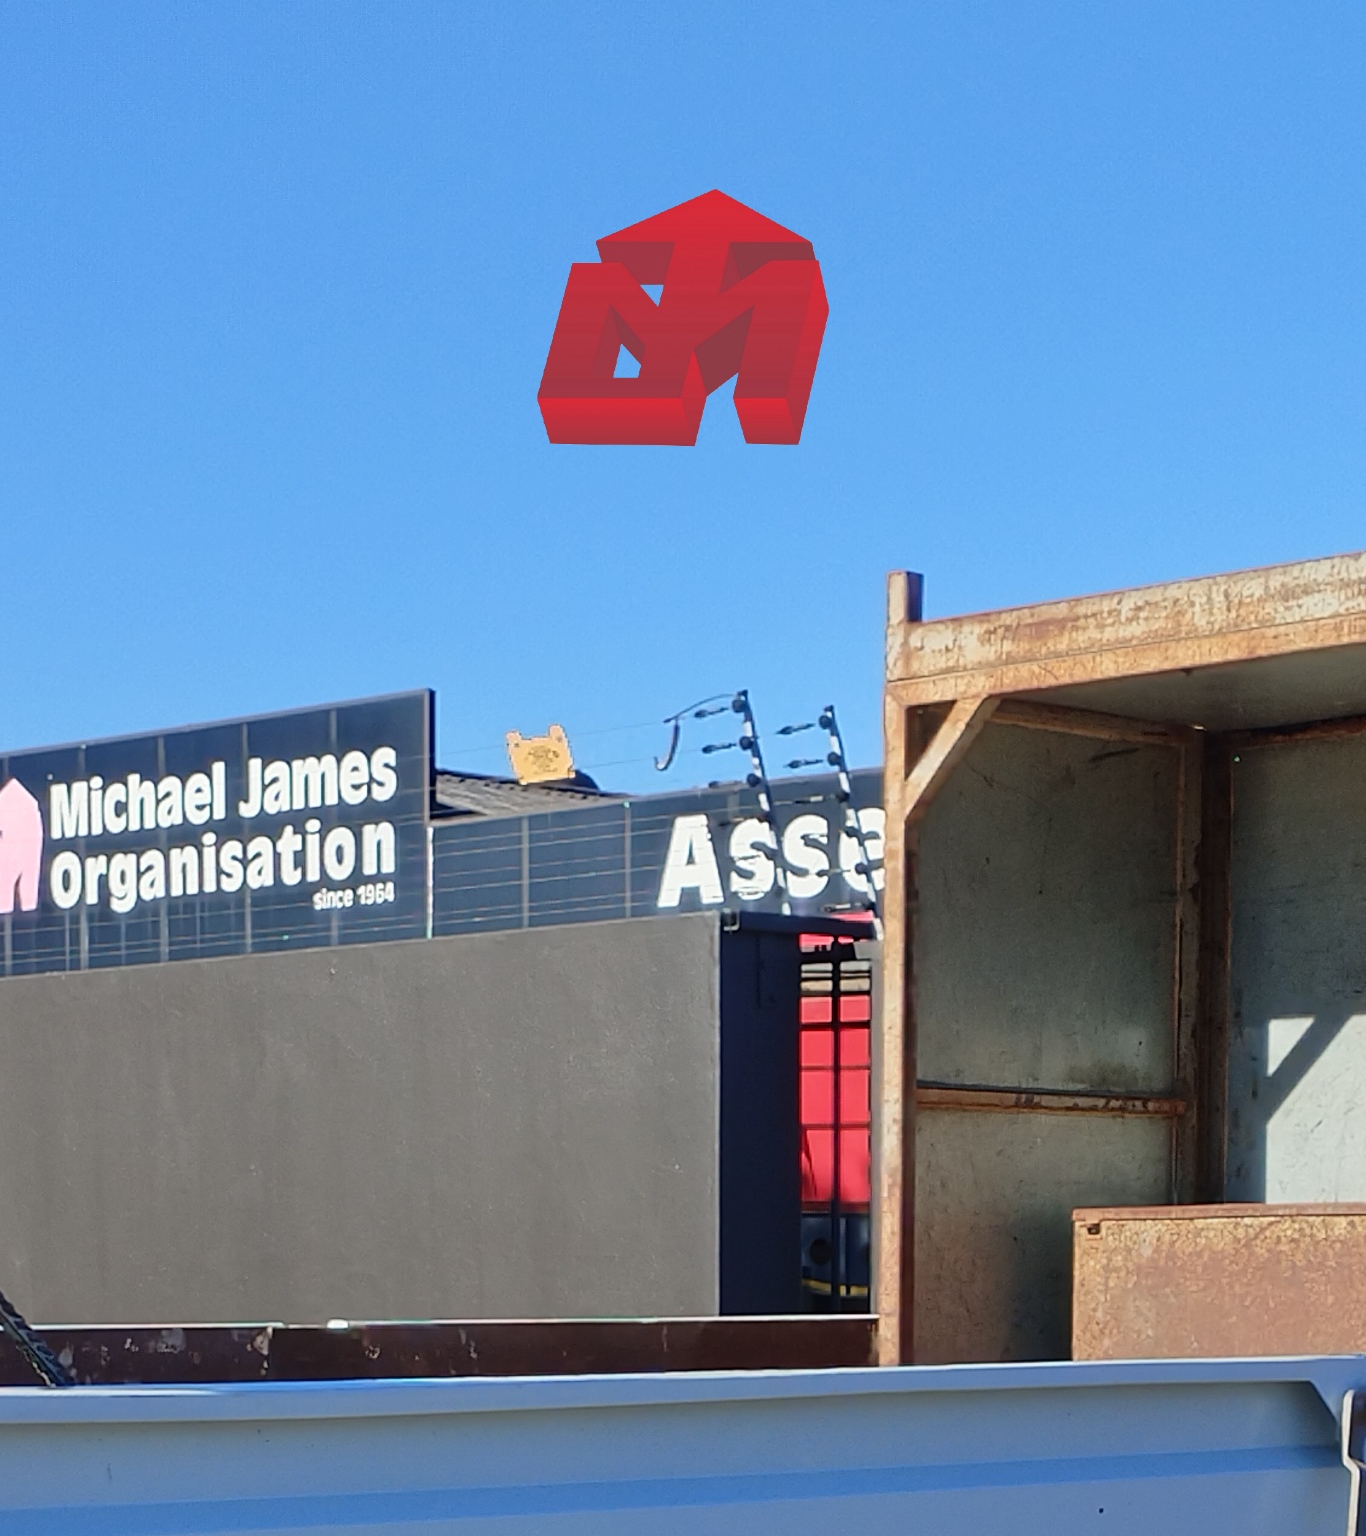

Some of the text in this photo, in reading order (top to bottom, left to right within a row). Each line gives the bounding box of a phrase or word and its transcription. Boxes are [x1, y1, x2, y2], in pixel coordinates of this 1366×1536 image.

[50, 746, 397, 840] Michael James
[50, 818, 396, 914] Organisation
[312, 881, 395, 911] since 1964
